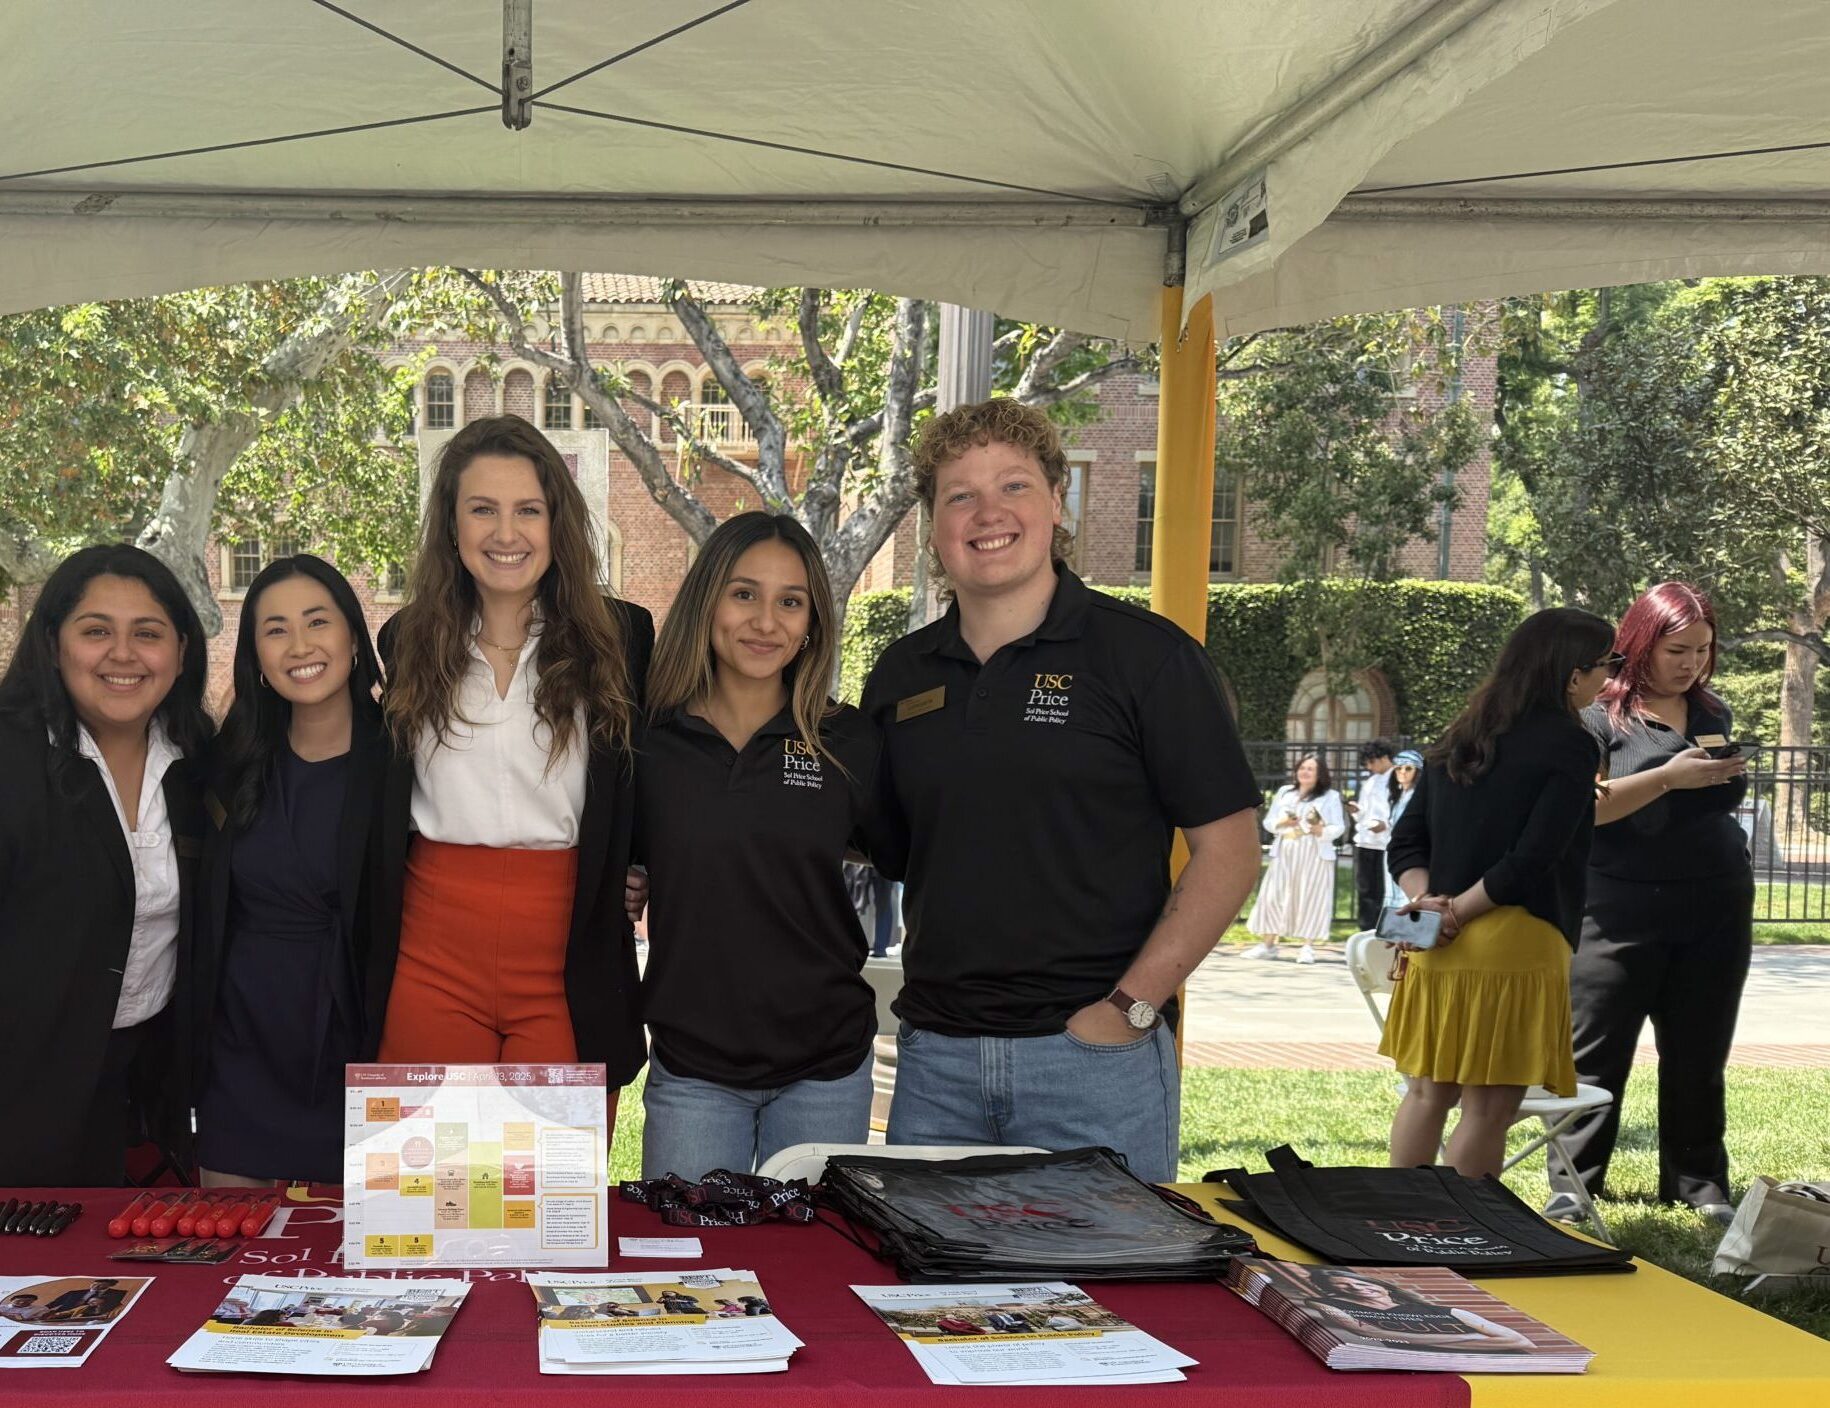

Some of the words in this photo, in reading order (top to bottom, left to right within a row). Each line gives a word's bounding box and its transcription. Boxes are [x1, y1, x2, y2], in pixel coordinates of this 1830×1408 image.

[1034, 673, 1073, 690] USC
[1026, 689, 1069, 706] Price
[1025, 707, 1035, 715] Sol
[1035, 708, 1050, 716] Price
[1049, 708, 1070, 717] School
[1048, 716, 1067, 725] Policy
[783, 754, 821, 772] Price
[783, 771, 793, 779] Sol
[793, 772, 806, 780] Price
[806, 773, 823, 782] School
[790, 779, 806, 787] Public
[806, 781, 822, 790] Policy
[406, 1071, 444, 1084] Explore
[446, 1071, 466, 1080] USC
[509, 1071, 532, 1081] 2025
[723, 1186, 754, 1197] Price
[769, 1187, 801, 1209] Price
[699, 1214, 732, 1227] Price
[1364, 1218, 1469, 1233] USC
[1374, 1231, 1489, 1245] Price
[239, 1248, 311, 1265] Sol
[284, 1330, 344, 1338] Development
